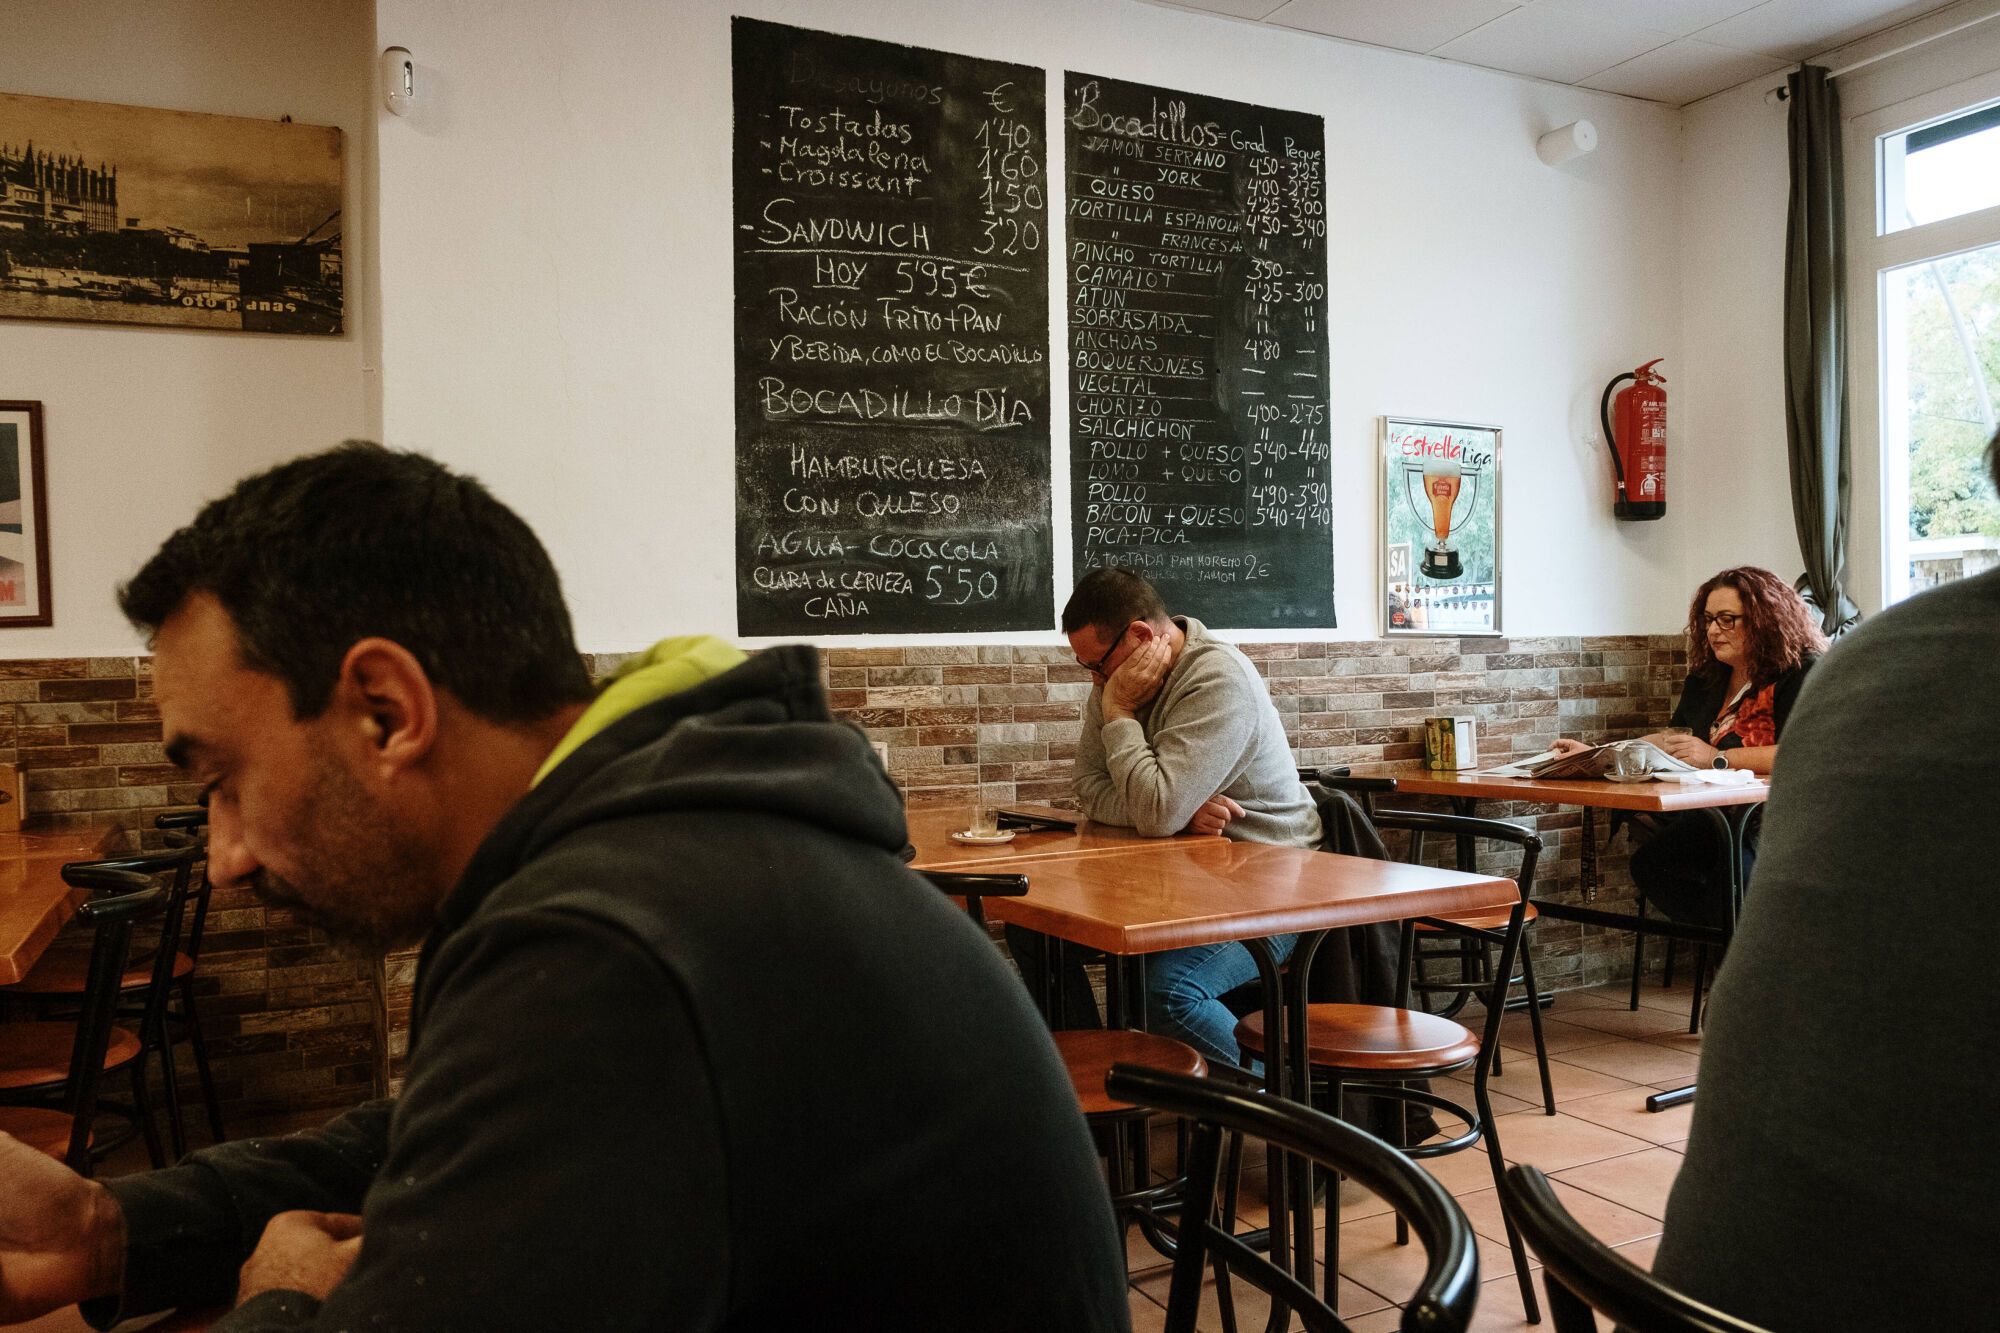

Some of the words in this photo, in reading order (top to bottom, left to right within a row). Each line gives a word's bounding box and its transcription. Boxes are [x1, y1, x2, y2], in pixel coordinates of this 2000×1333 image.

[779, 106, 912, 143] Tostadas
[779, 136, 932, 173] Magdalena
[1082, 137, 1144, 157] JAMON
[1155, 145, 1226, 168] SERRANO
[778, 160, 922, 195] Croissant
[1157, 168, 1202, 187] YORK
[1091, 179, 1154, 201] QUESO
[1069, 199, 1153, 222] TORTILLA
[1072, 242, 1135, 262] PINCHO
[1149, 253, 1223, 273] TORTILLA
[815, 254, 867, 287] HOY
[1075, 264, 1175, 288] CAMAIOT
[1075, 286, 1126, 308] ATUN
[1072, 308, 1192, 333] SOBRASADA
[949, 340, 1042, 364] BOCADILLO
[1075, 330, 1158, 351] ANCHOAS
[1075, 351, 1204, 375] BOQUERONES
[1079, 375, 1157, 395] VEGETAL
[759, 377, 961, 419] BOCADILLO
[1076, 397, 1162, 417] CHORIZO
[1078, 418, 1195, 441] SALCHICHON
[1091, 441, 1147, 460] POLLO
[1180, 444, 1243, 462] QUESO
[1401, 435, 1461, 459] Estrella
[791, 443, 987, 481] HAMBURGUESA
[1462, 448, 1492, 471] Liga
[1088, 464, 1139, 481] LOMO
[1181, 465, 1242, 483] QUESO
[784, 488, 839, 515] CON
[856, 491, 959, 516] QUESO
[1088, 484, 1146, 502] POLLO
[1086, 505, 1152, 524] BACON
[1181, 506, 1245, 526] QUESO
[1087, 527, 1190, 546] PICA-PICA
[1104, 552, 1164, 567] TOSTADA
[753, 567, 811, 591] CLARA
[817, 570, 836, 589] de
[841, 570, 912, 594] CERVEZA
[1198, 570, 1235, 582] JAMON
[804, 593, 869, 618] CAÑA
